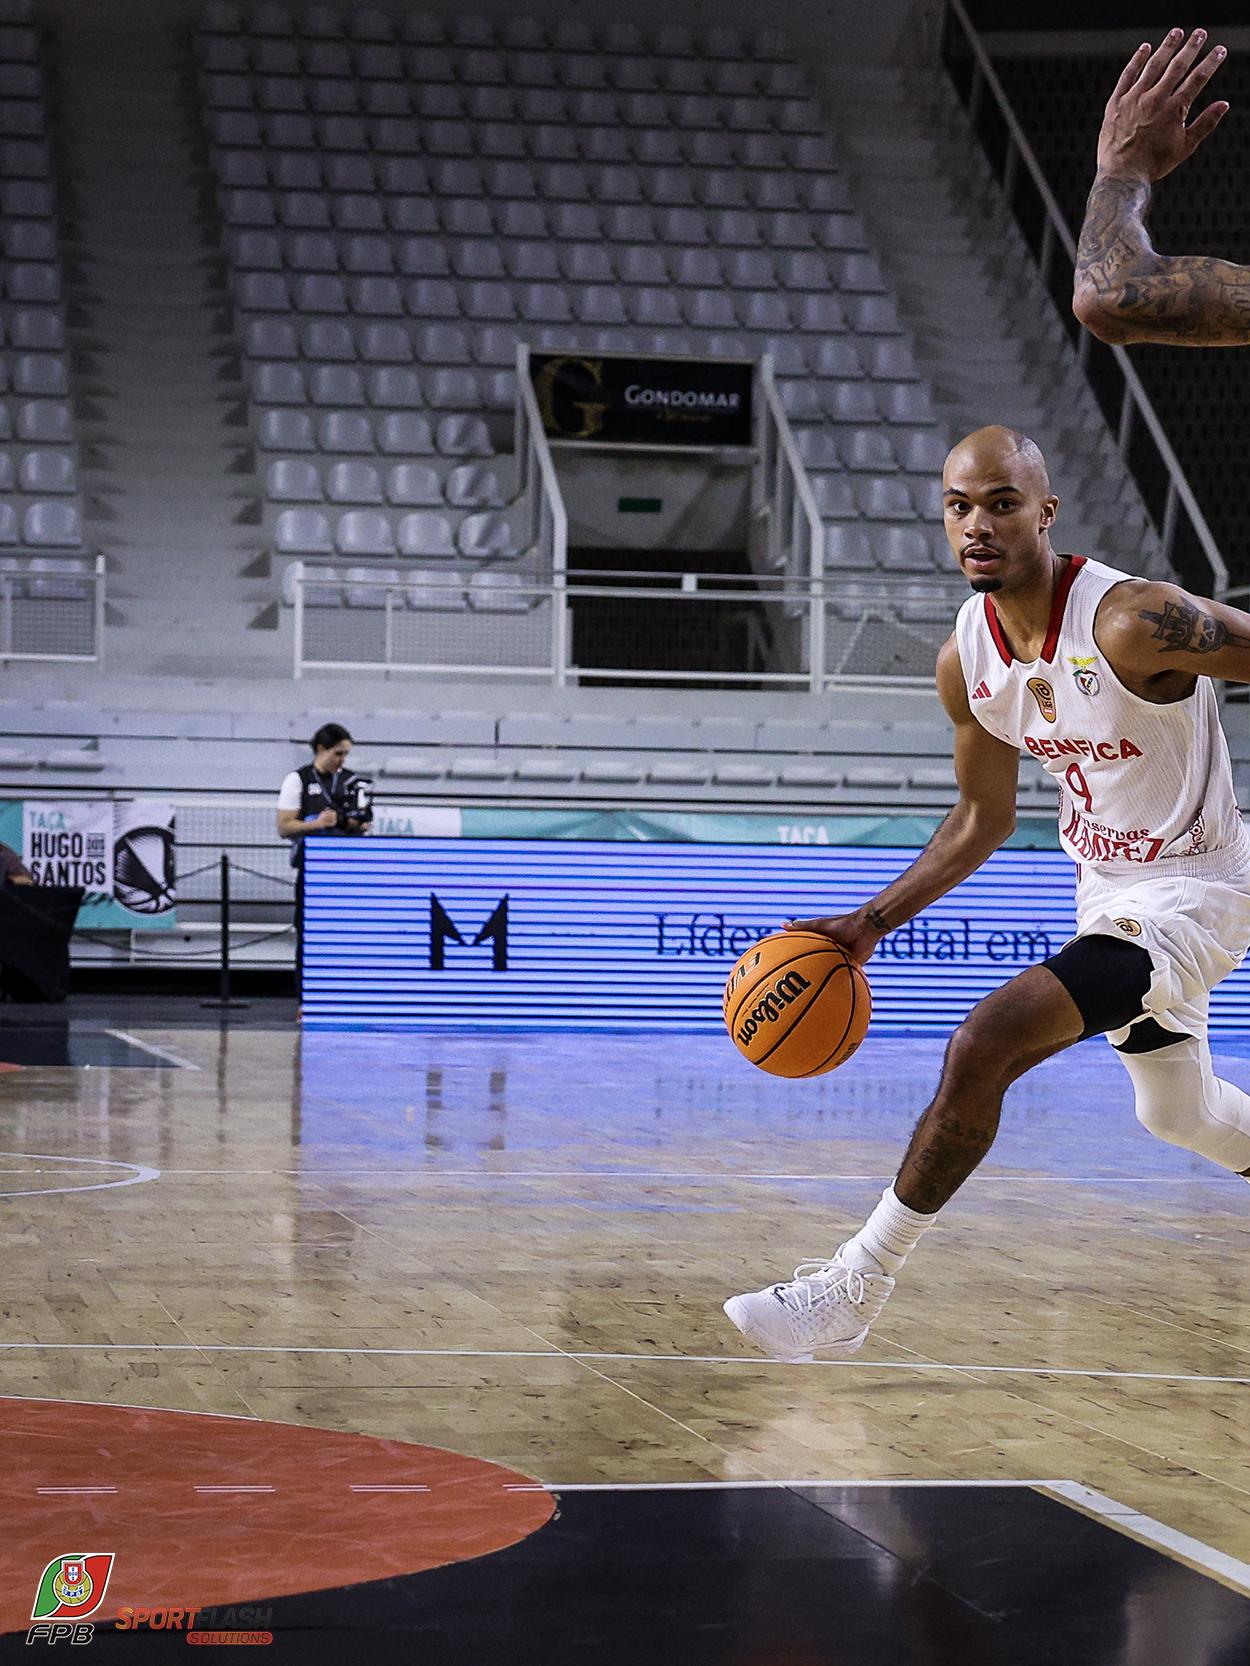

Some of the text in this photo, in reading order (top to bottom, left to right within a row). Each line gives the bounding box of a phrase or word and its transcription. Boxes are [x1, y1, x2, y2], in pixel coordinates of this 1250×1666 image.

[624, 384, 742, 409] GONDOMAR
[1024, 736, 1143, 763] BENFICA
[1065, 762, 1093, 813] 9
[31, 832, 84, 859] HUGO
[30, 861, 106, 888] SANTOS
[430, 891, 508, 971] M
[985, 929, 1053, 961] em
[736, 970, 812, 1047] Wilson
